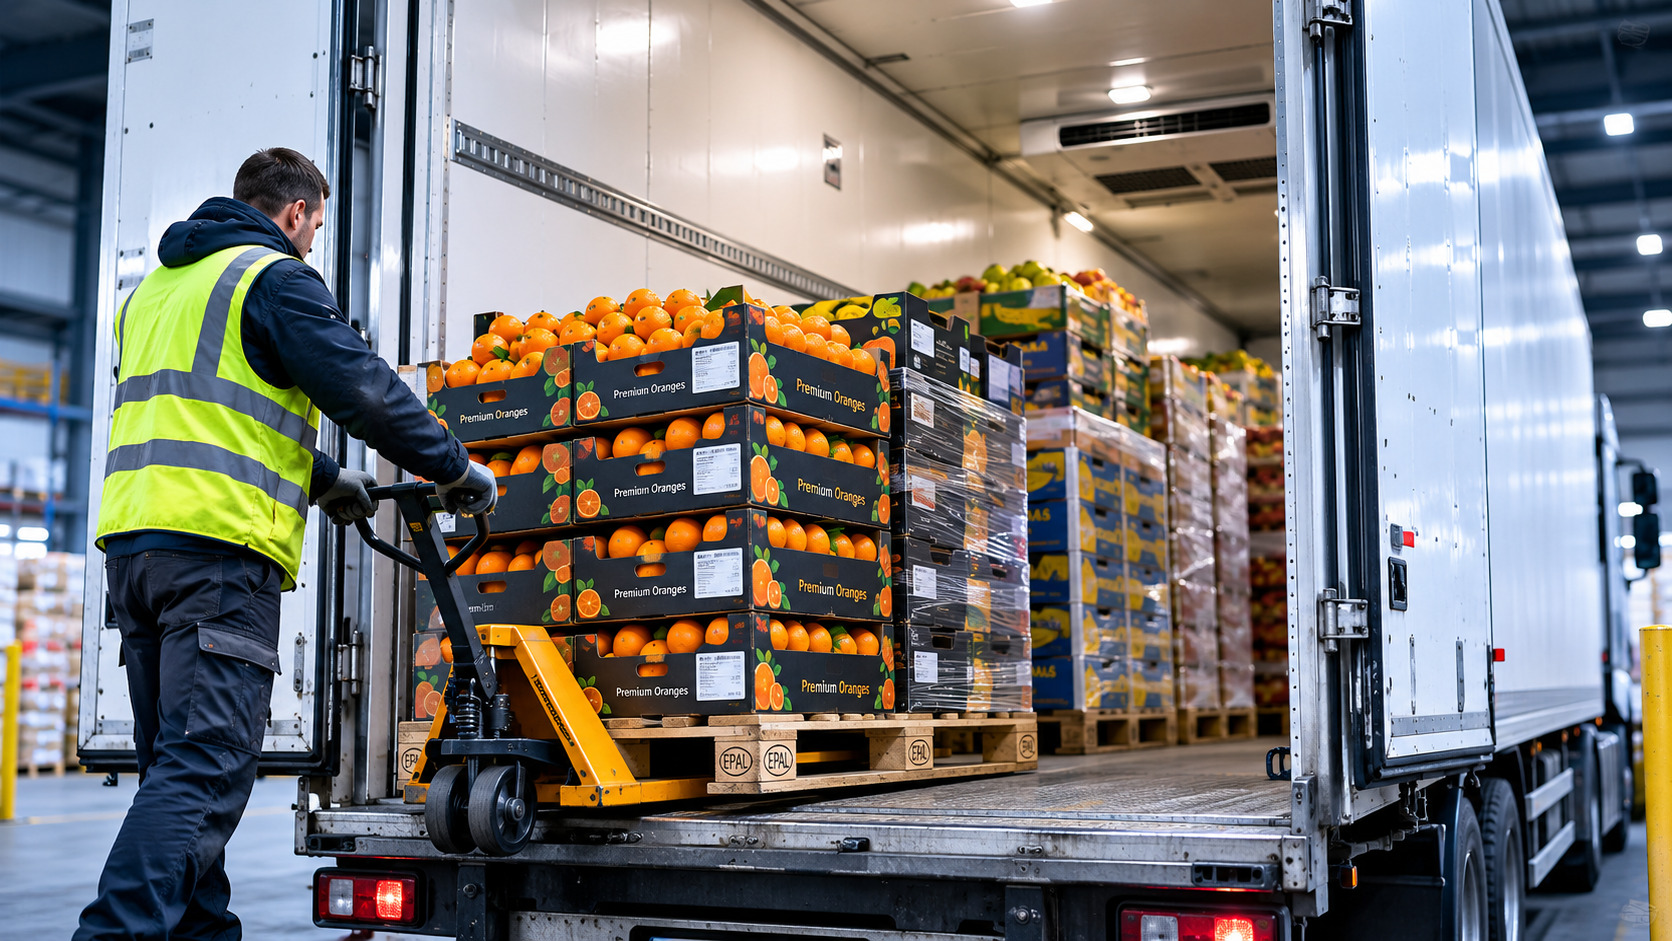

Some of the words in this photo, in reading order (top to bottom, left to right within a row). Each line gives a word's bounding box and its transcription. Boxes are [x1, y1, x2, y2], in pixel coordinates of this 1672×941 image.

[651, 381, 686, 393] Oranges
[796, 378, 833, 402] Premium
[834, 390, 866, 413] Oranges
[460, 412, 494, 424] Premium
[495, 408, 528, 419] Oranges
[651, 482, 686, 494] Oranges
[797, 477, 833, 498] Premium
[834, 486, 866, 508] Oranges
[614, 587, 650, 599] Premium
[652, 585, 687, 597] Oranges
[798, 578, 834, 596] Premium
[835, 583, 867, 603] Oranges
[616, 686, 652, 697] Premium
[654, 686, 689, 699] Oranges
[801, 679, 837, 694] Premium
[839, 680, 870, 699] Oranges
[723, 753, 748, 770] EPAL
[768, 751, 790, 769] EPAL
